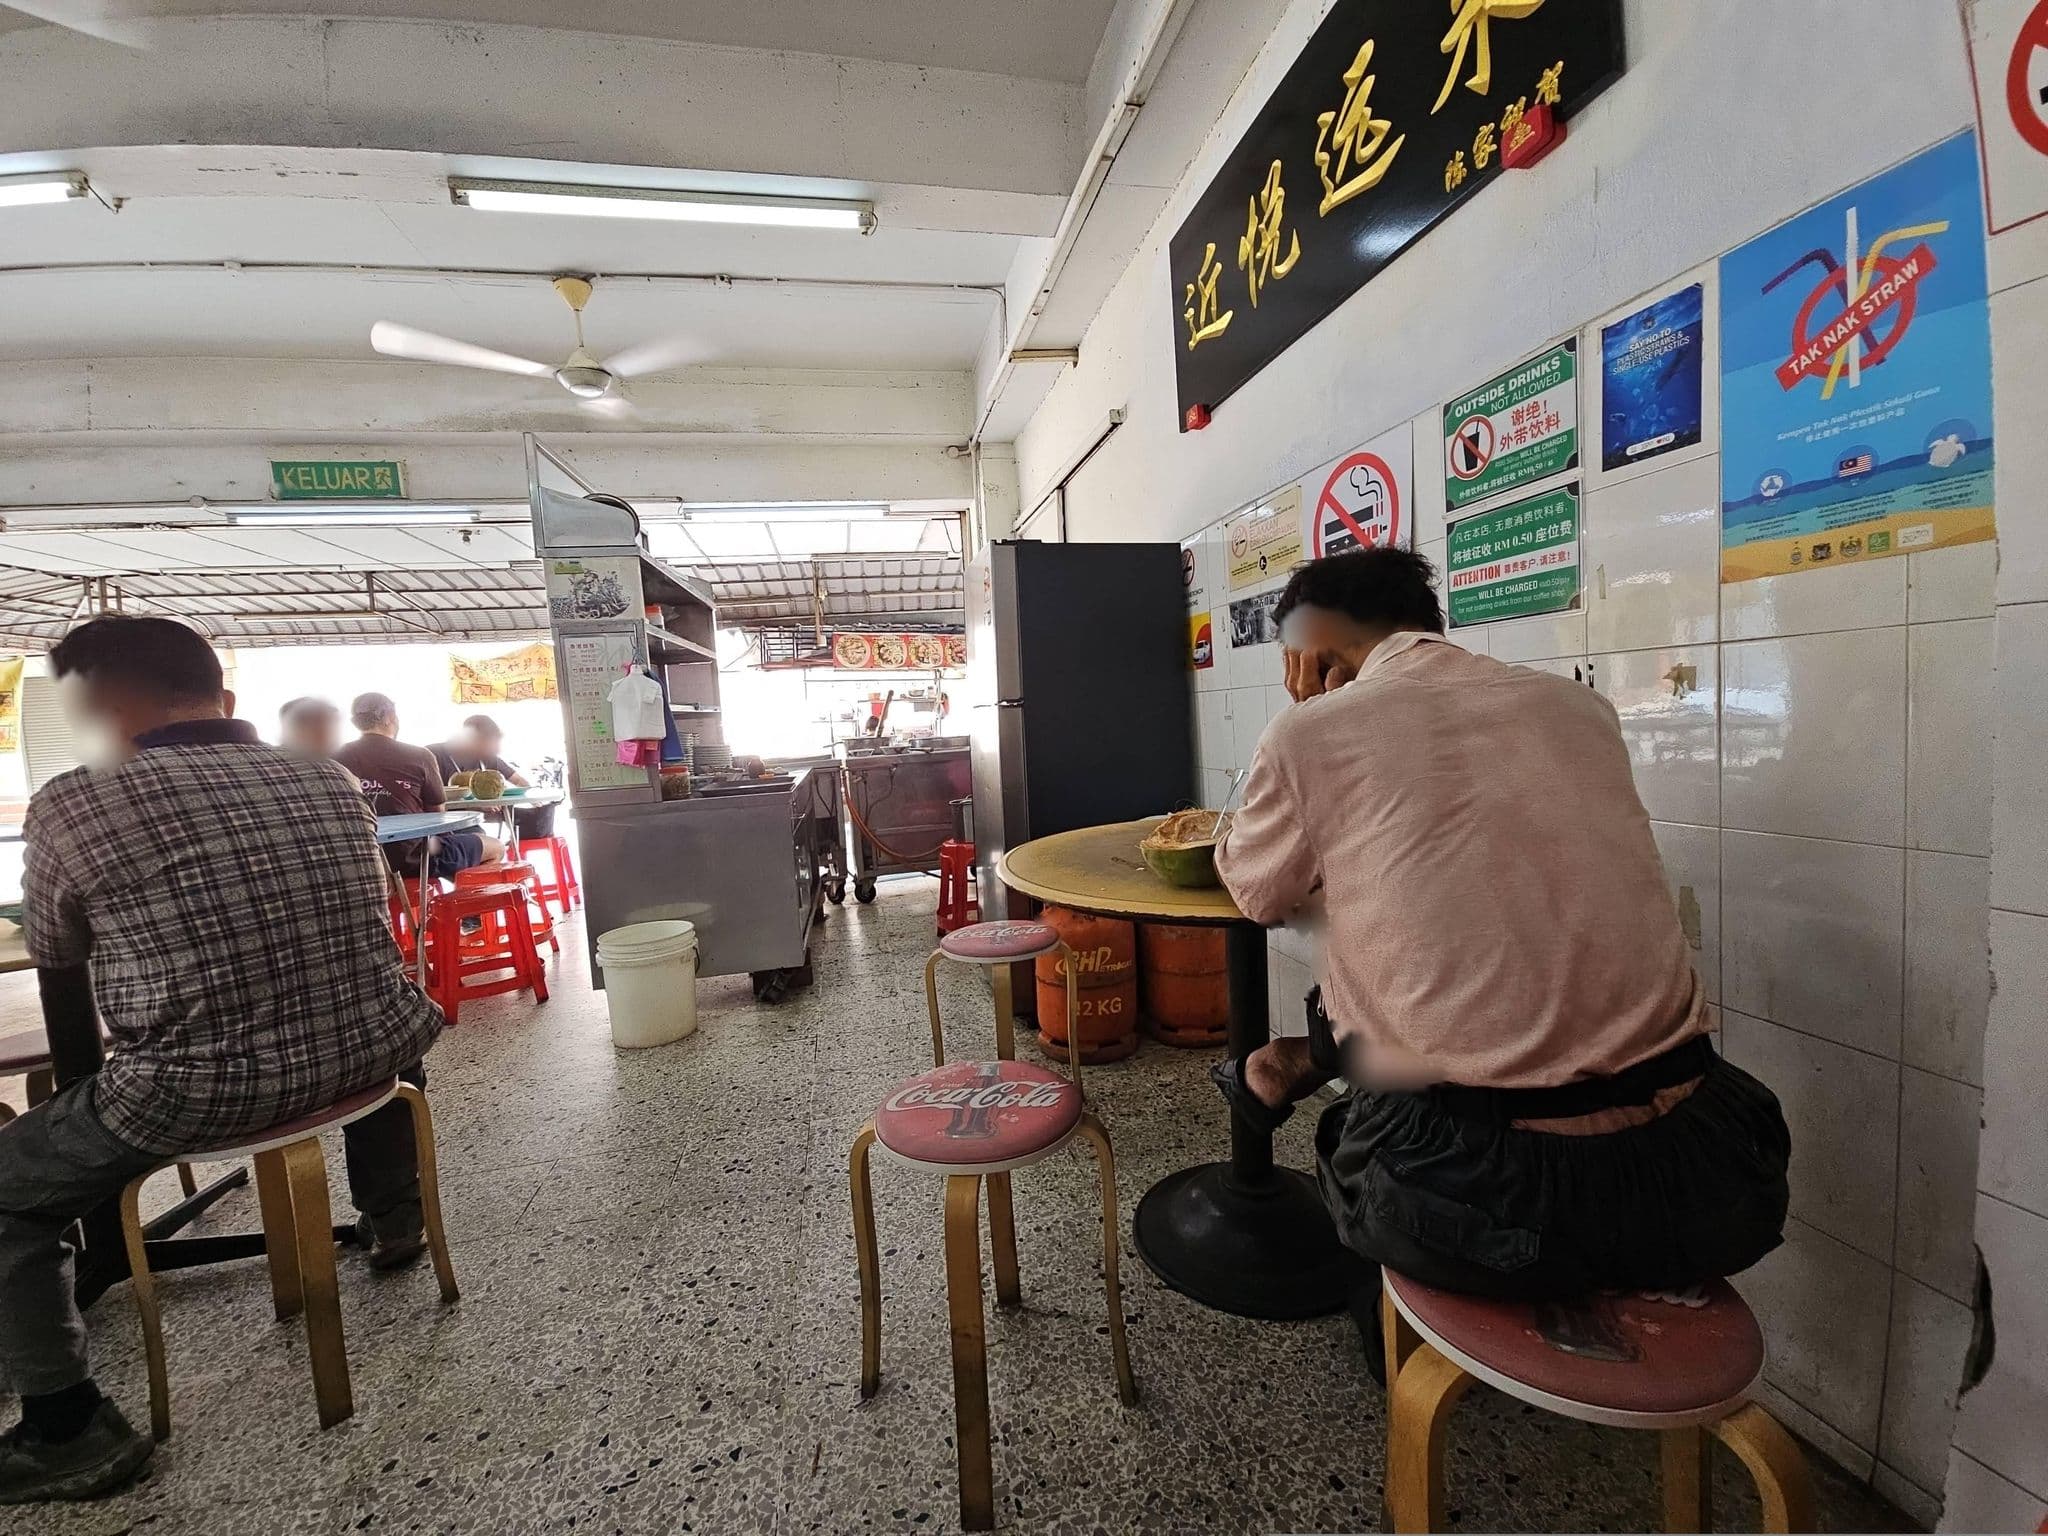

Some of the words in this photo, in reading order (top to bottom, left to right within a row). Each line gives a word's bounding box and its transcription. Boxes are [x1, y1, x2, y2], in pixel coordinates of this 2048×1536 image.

[1788, 342, 1824, 377] TAK
[1822, 311, 1861, 350] NAK
[1861, 257, 1920, 318] STRAW
[1629, 338, 1645, 351] SAY
[1645, 333, 1659, 345] NO
[1659, 327, 1672, 339] TO
[1653, 336, 1690, 360] PLASTICS
[1454, 383, 1506, 418] OUTSIDE
[1508, 356, 1561, 392] DRINKS
[1490, 396, 1510, 413] NOT
[1512, 371, 1561, 403] ALLOWED
[1499, 411, 1561, 451] 外带饮料
[281, 466, 372, 490] KELUAR
[1494, 539, 1510, 553] RM
[1512, 533, 1533, 548] 0.50
[1535, 519, 1573, 544] 座位费
[1453, 564, 1501, 588] ATTENTION
[1478, 589, 1494, 600] WILL
[1495, 588, 1504, 596] BE
[1505, 580, 1538, 595] CHARGED
[1097, 997, 1122, 1016] KG
[885, 1080, 1075, 1112] Coca-Cola
